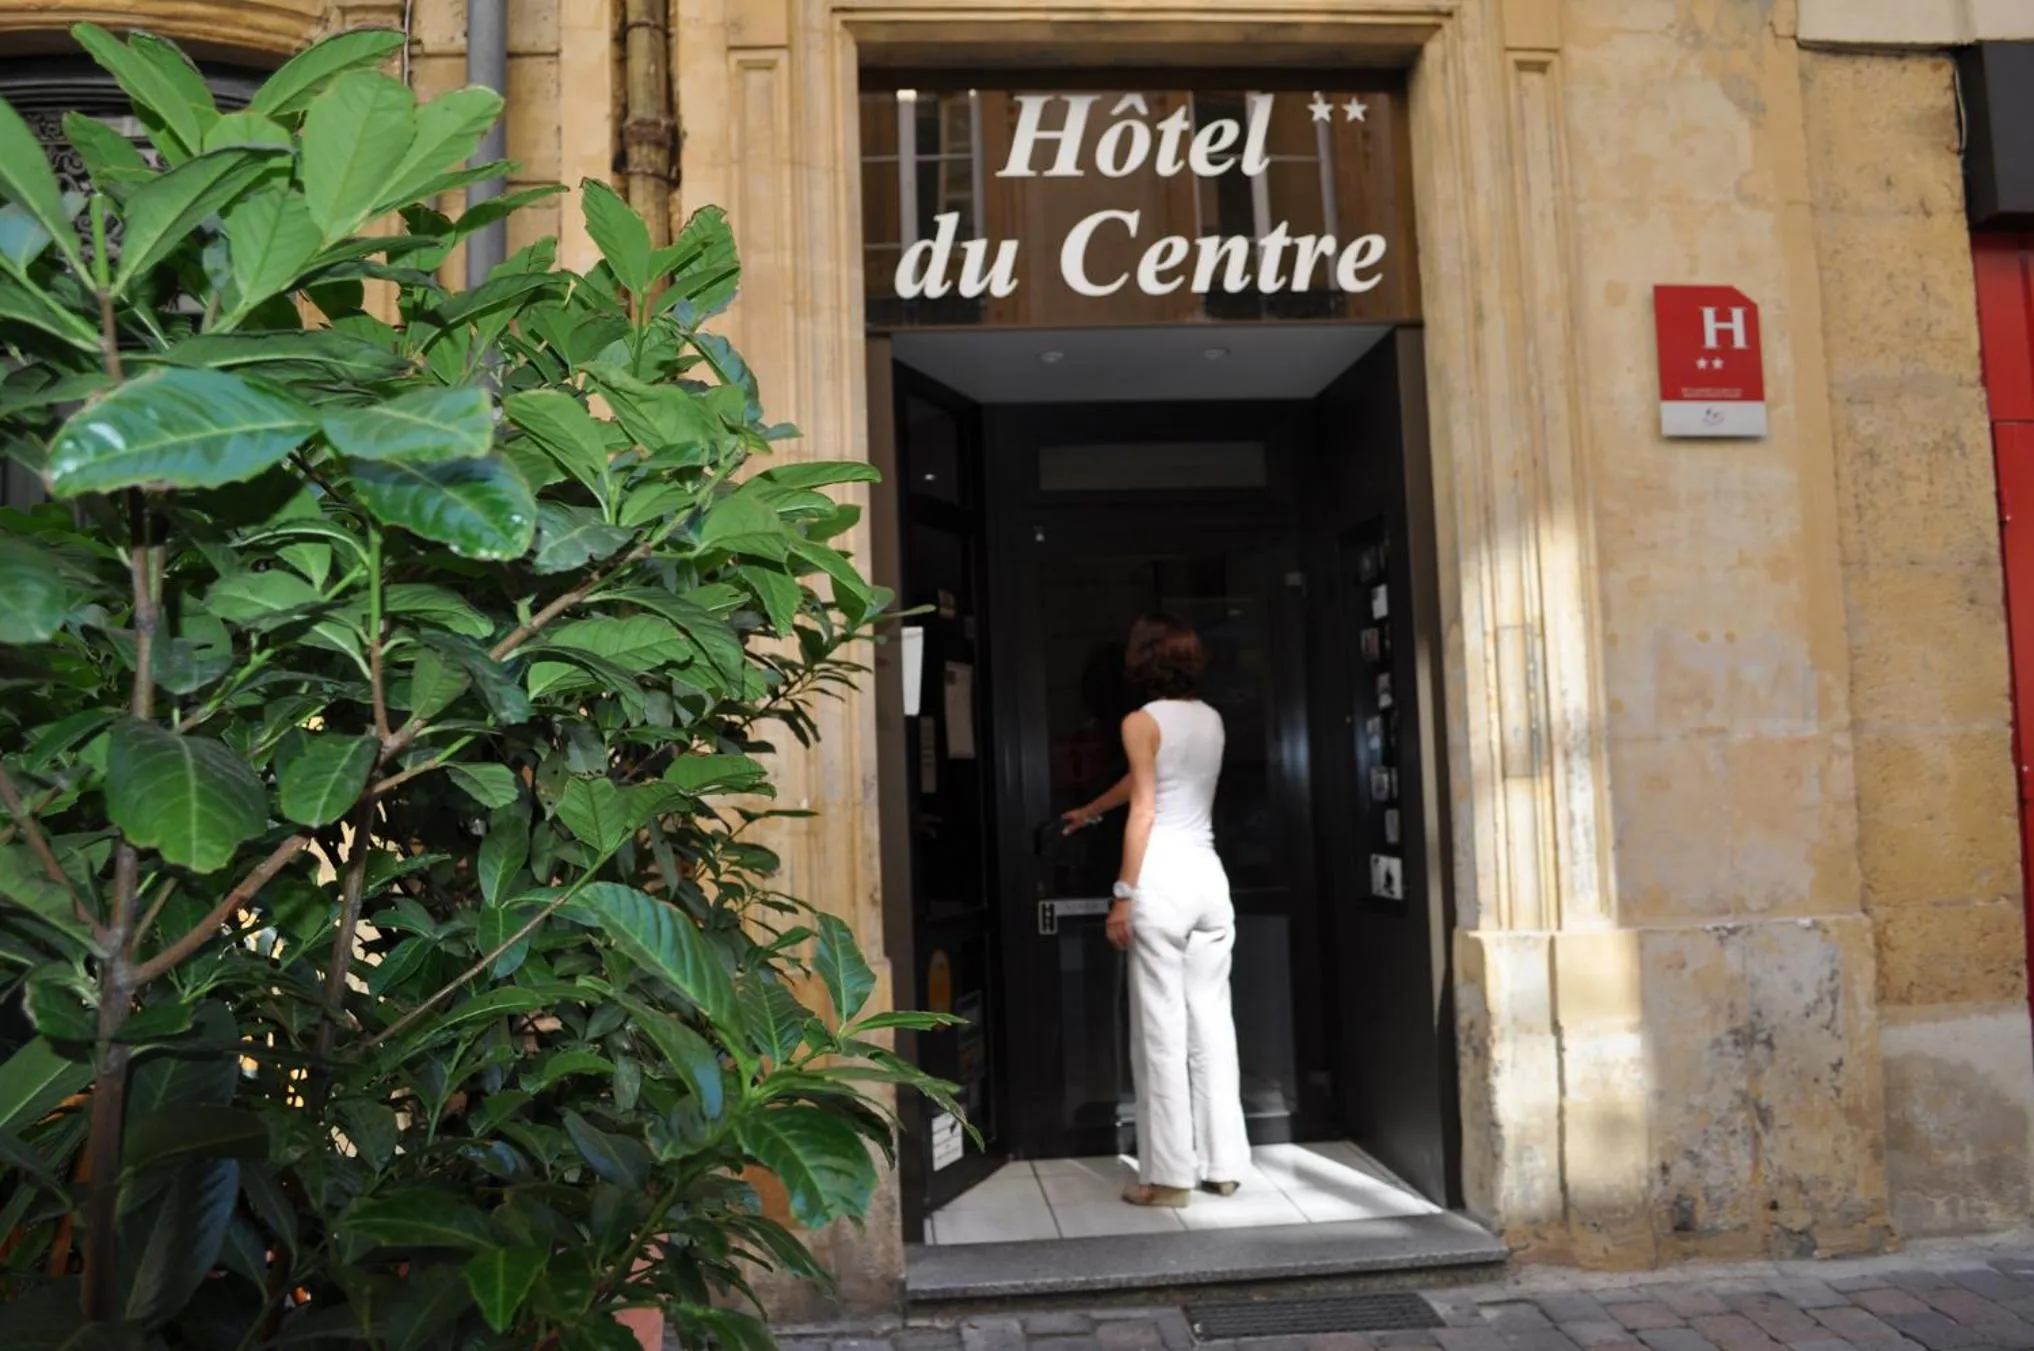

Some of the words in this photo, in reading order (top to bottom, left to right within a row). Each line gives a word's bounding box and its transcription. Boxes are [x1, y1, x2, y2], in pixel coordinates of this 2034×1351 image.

[995, 92, 1275, 178] Hôtel
[894, 211, 1020, 300] du
[1060, 208, 1388, 297] Centre
[1699, 306, 1751, 350] H
